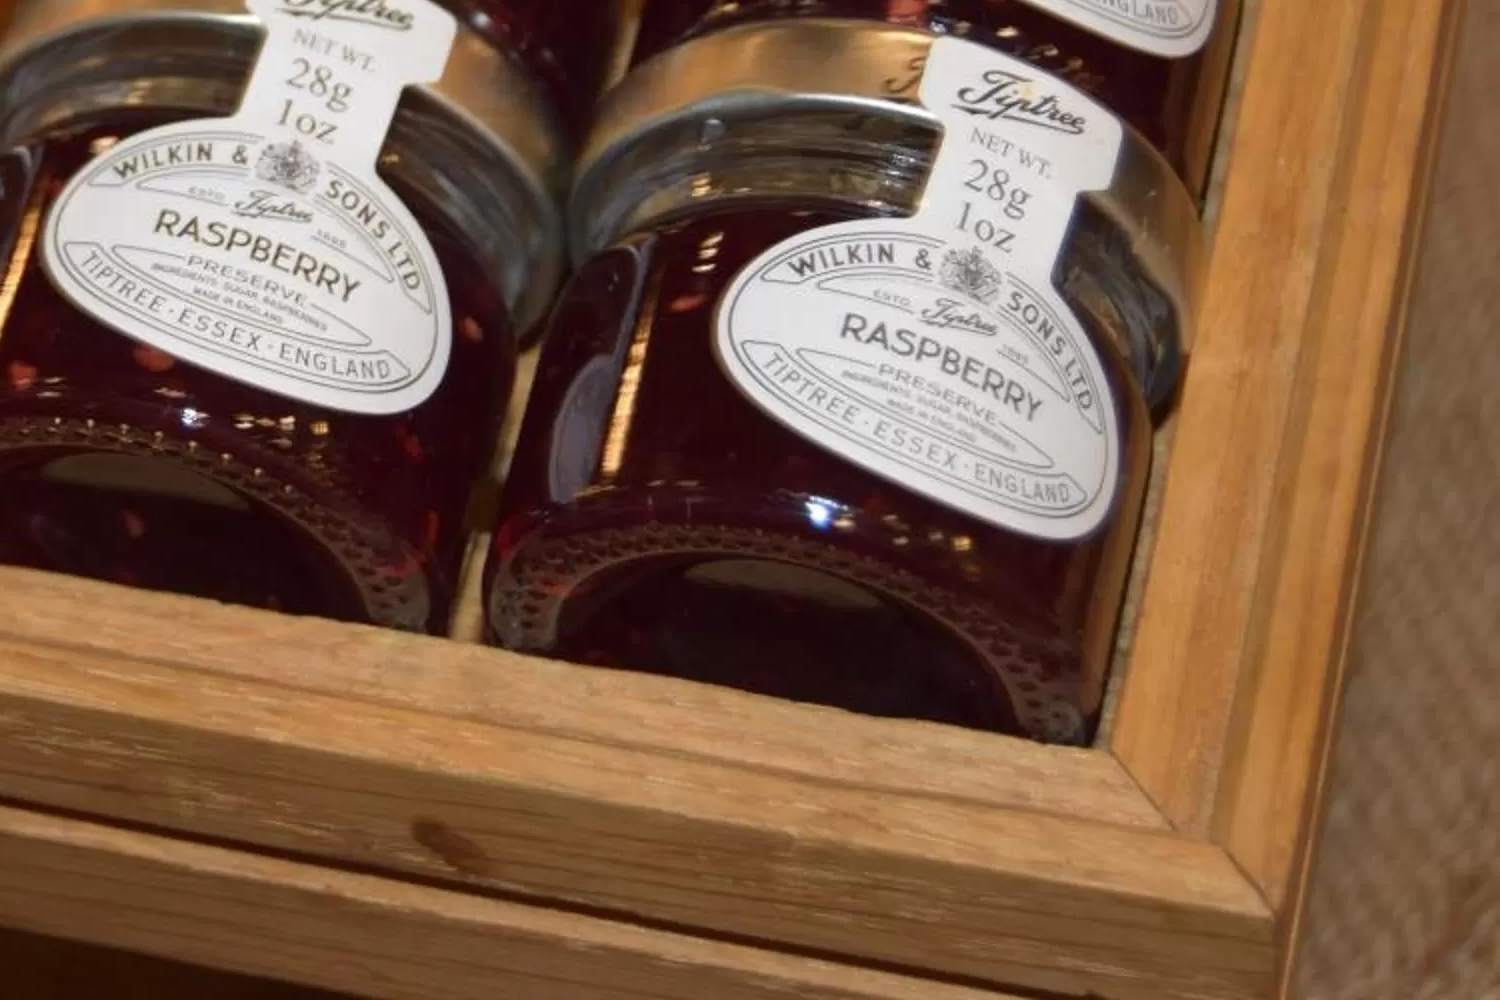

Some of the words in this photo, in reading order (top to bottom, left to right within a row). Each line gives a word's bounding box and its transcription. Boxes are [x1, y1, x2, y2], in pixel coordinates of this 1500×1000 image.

[284, 56, 354, 113] 28g
[950, 69, 1086, 136] Tiptree
[276, 99, 338, 146] 1oz
[970, 126, 1015, 158] NET
[112, 141, 213, 180] WILKIN
[231, 145, 249, 166] &
[325, 179, 390, 242] SONS
[387, 240, 421, 292] LTD
[963, 158, 1032, 221] 28g
[153, 207, 362, 304] RASPBERRY
[954, 203, 1014, 254] 1oz
[187, 255, 309, 309] PRESERVE
[80, 250, 164, 315] TIPTREE
[177, 308, 260, 354] ESSEX
[279, 341, 392, 380] ENGLAND
[788, 242, 895, 277] WILKIN
[914, 249, 933, 271] &
[1006, 291, 1066, 355] SONS
[1063, 358, 1095, 411] LTD
[840, 312, 1044, 423] RASPBERRY
[878, 363, 998, 426] PRESERVE
[763, 350, 861, 426] TIPTREE
[873, 418, 958, 469] ESSEX
[974, 461, 1071, 503] ENGLAND
